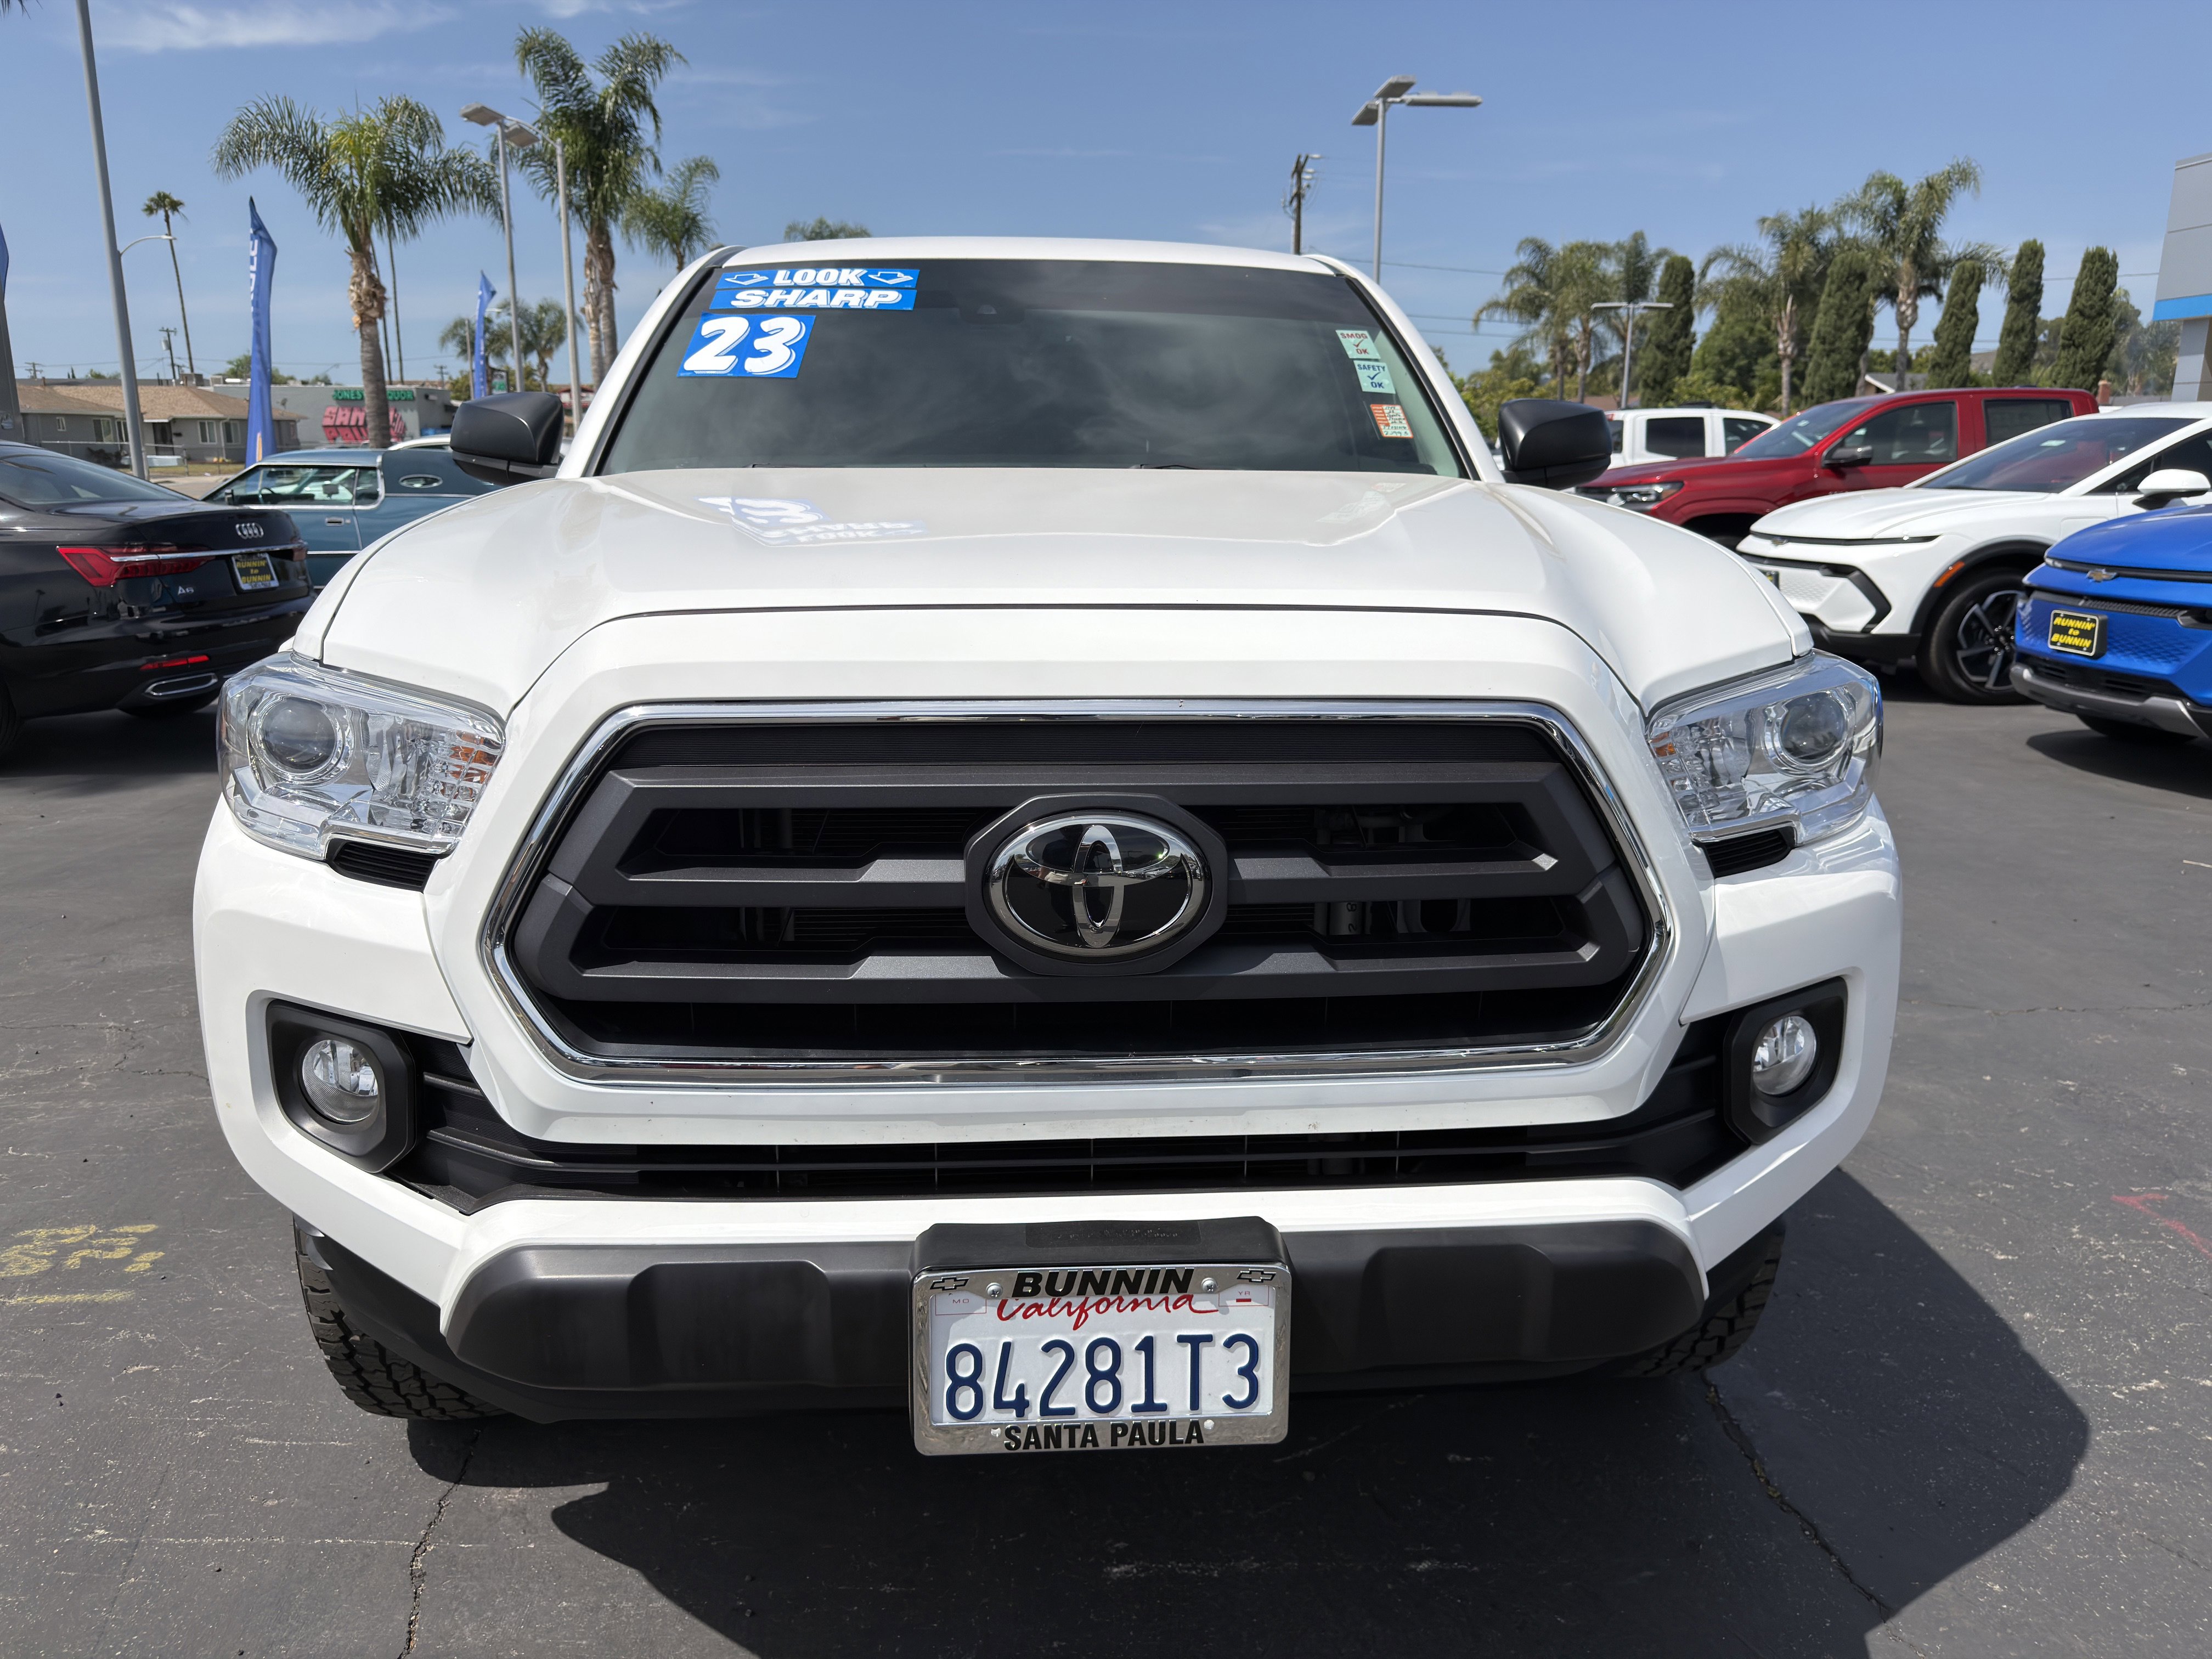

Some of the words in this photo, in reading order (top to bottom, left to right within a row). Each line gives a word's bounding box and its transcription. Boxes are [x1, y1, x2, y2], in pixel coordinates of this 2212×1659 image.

[773, 268, 868, 286] LOOK
[730, 289, 902, 309] SHARP
[683, 317, 806, 375] 23
[387, 390, 415, 400] QUOR
[2051, 633, 2092, 648] BUNNIN
[1012, 1267, 1194, 1297] BUNNIN
[997, 1294, 1218, 1330] California
[946, 1333, 1259, 1420] 84281T3
[1003, 1422, 1099, 1451] SANTA
[1110, 1419, 1204, 1447] PAULA
